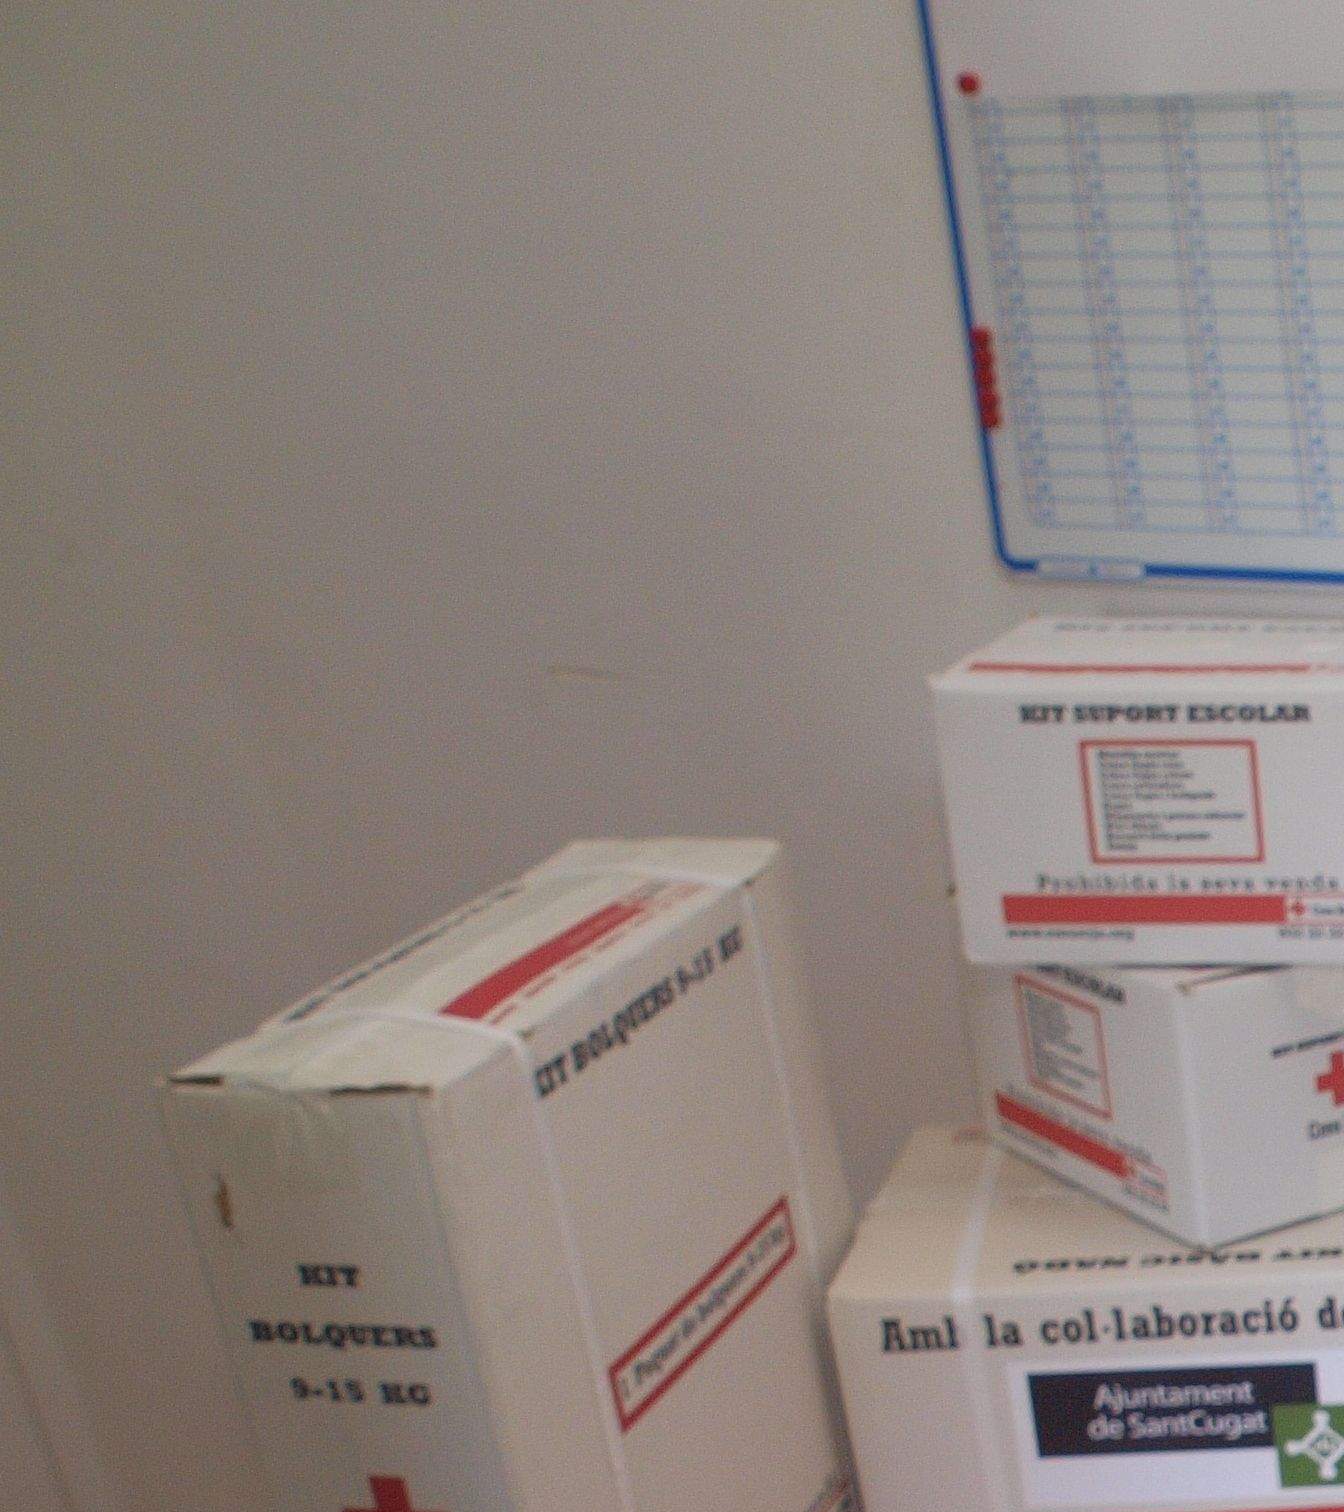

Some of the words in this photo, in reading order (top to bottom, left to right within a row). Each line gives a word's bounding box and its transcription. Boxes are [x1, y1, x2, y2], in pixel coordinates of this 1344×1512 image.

[1019, 702, 1063, 724] KIT
[1073, 702, 1178, 724] SUPORT
[1187, 702, 1311, 724] ESCOLAR
[299, 1263, 361, 1288] KIT
[249, 1319, 438, 1349] BOLQUERS
[983, 1311, 1025, 1348] la
[1040, 1297, 1299, 1346] col·laboració
[1092, 1380, 1255, 1415] Ajuntament
[1086, 1413, 1126, 1442] de
